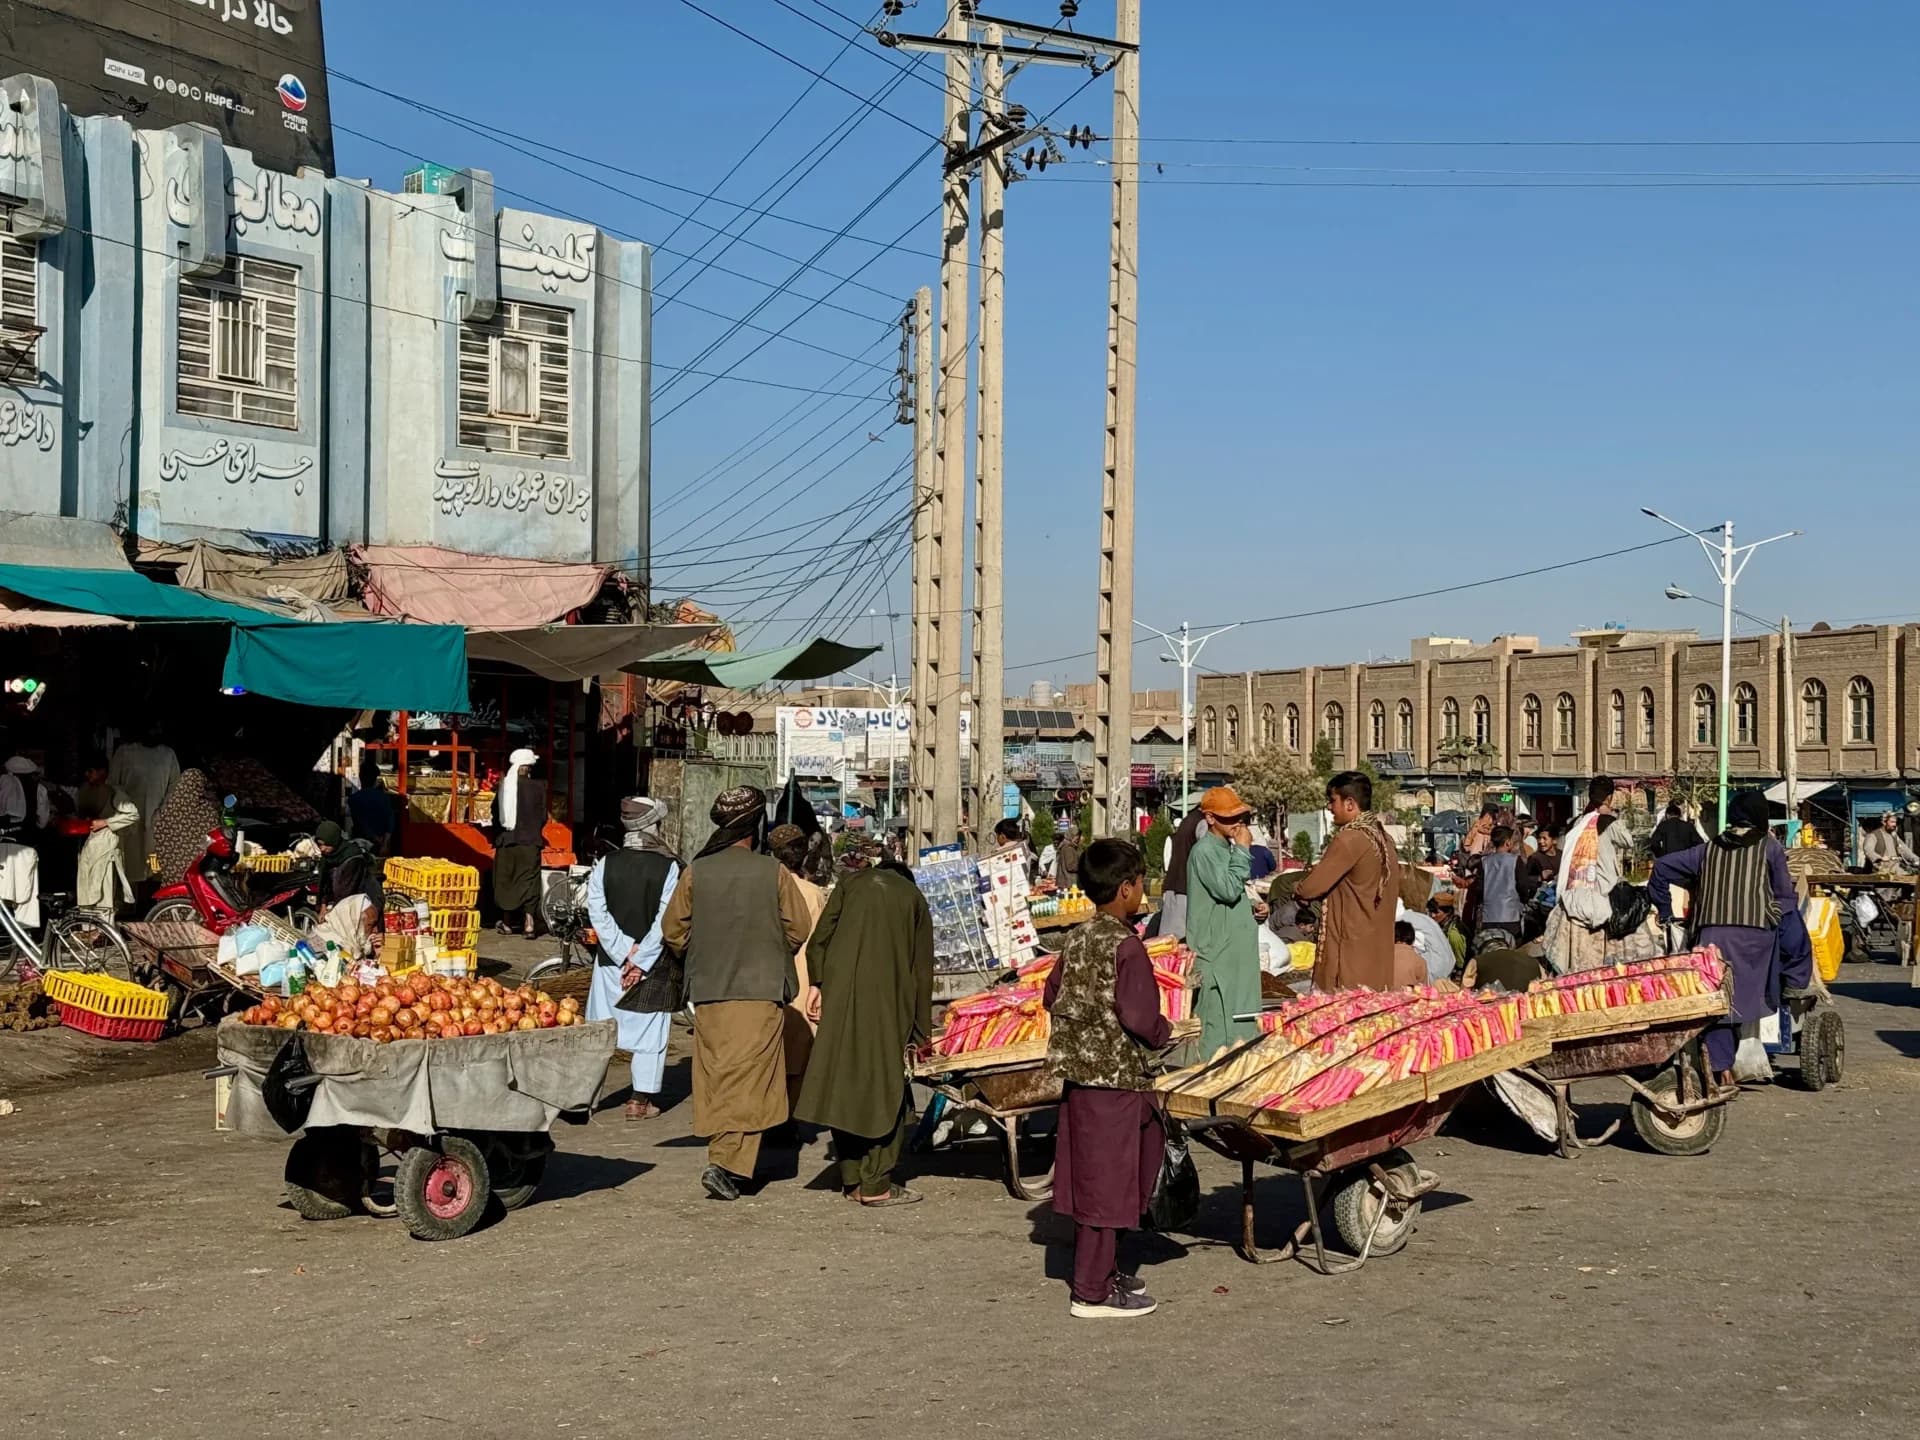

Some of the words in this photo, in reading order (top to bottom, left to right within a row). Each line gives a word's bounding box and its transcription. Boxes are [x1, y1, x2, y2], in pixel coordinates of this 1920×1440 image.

[253, 0, 293, 35] حالا
[106, 63, 126, 76] JOIN
[204, 91, 255, 117] HYPE.COM
[281, 111, 309, 127] PAMIR
[283, 120, 307, 134] COLA
[160, 439, 229, 482] عصبی
[223, 442, 313, 496] جراحی
[502, 471, 545, 512] عمومی
[544, 476, 591, 522] جراحی
